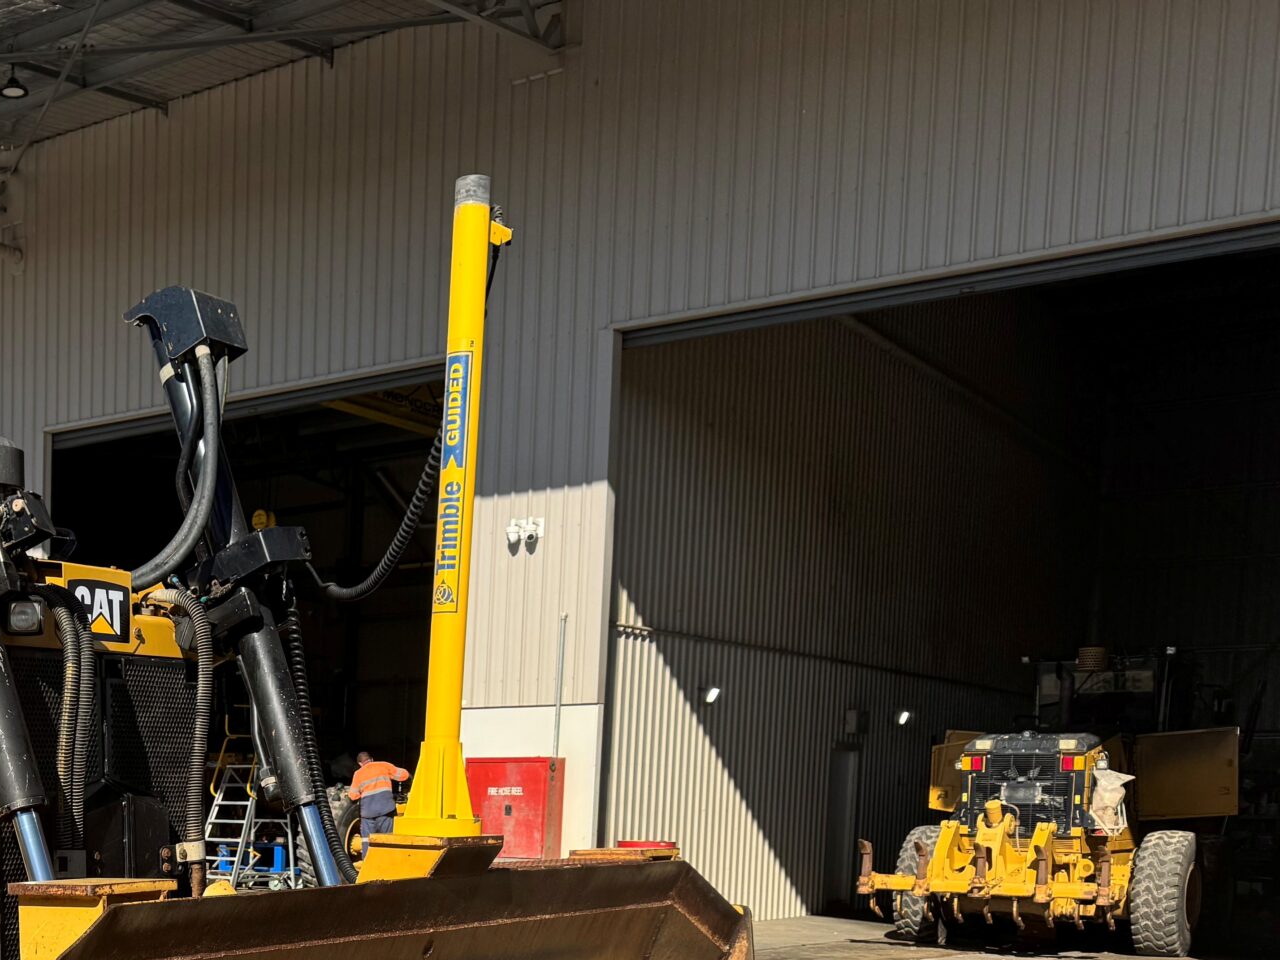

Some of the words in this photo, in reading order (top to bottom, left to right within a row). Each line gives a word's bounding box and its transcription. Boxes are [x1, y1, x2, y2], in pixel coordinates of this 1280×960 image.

[383, 390, 442, 415] MONOCR
[446, 363, 464, 446] GUIDED
[435, 481, 462, 576] Trimble
[488, 787, 498, 796] FIRE
